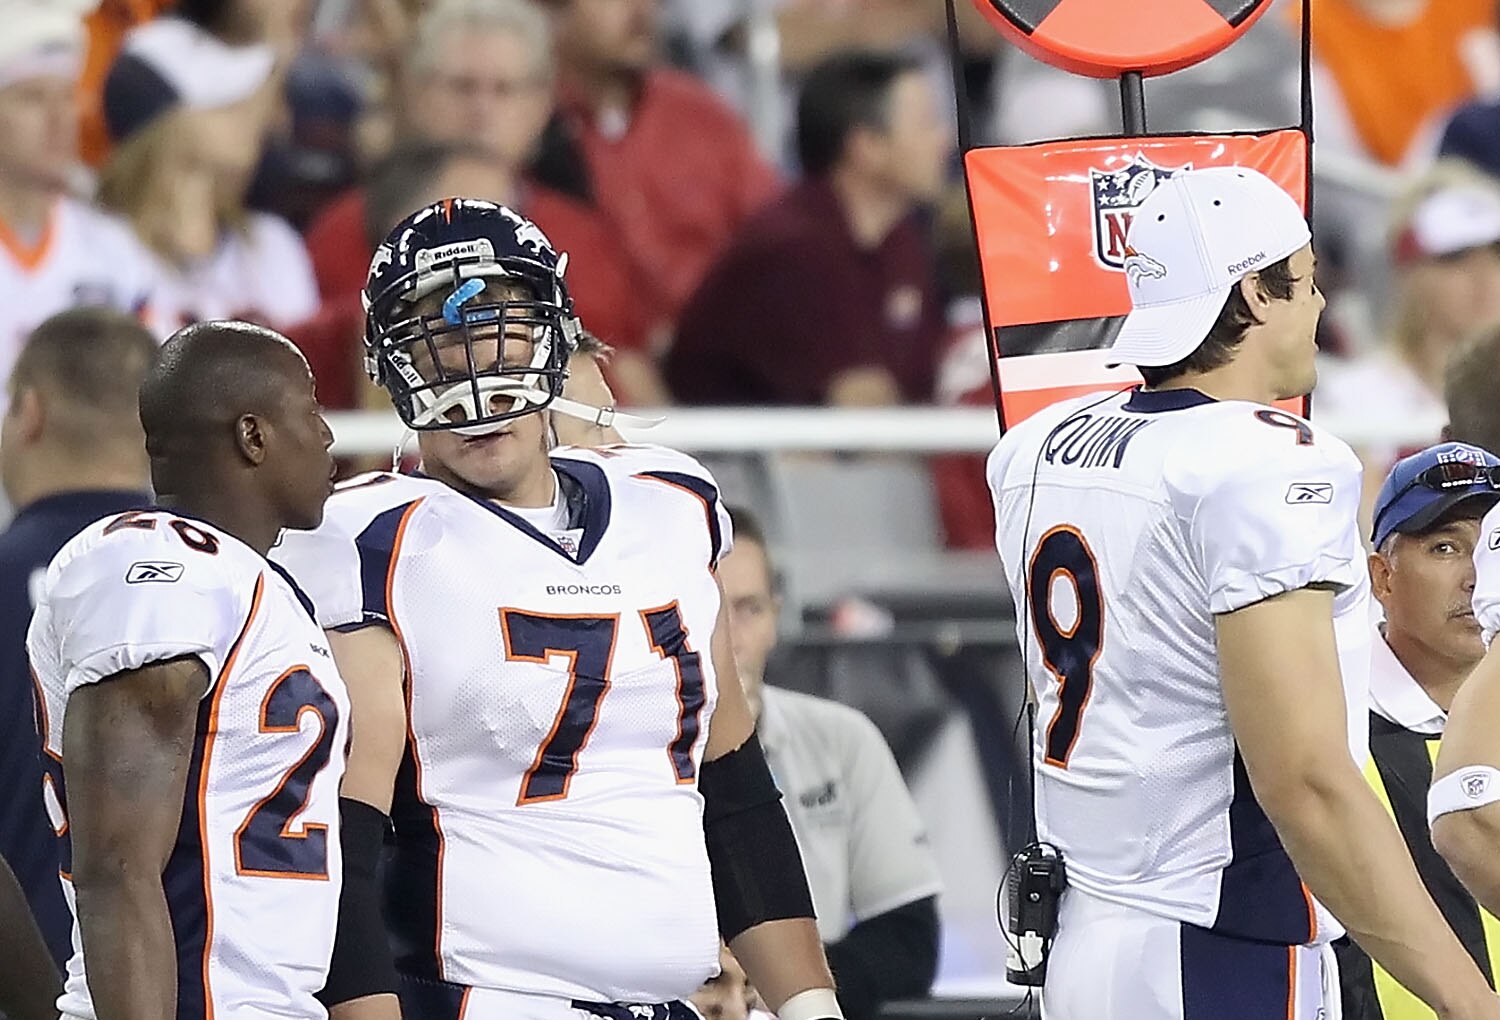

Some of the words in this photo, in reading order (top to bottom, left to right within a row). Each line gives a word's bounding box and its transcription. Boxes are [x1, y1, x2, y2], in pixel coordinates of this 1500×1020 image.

[434, 243, 475, 261] Riddell
[1227, 249, 1268, 276] Reebok
[546, 585, 622, 595] BRONCOS
[1028, 524, 1105, 770] 9
[498, 599, 707, 807] 71
[234, 664, 338, 881] 2
